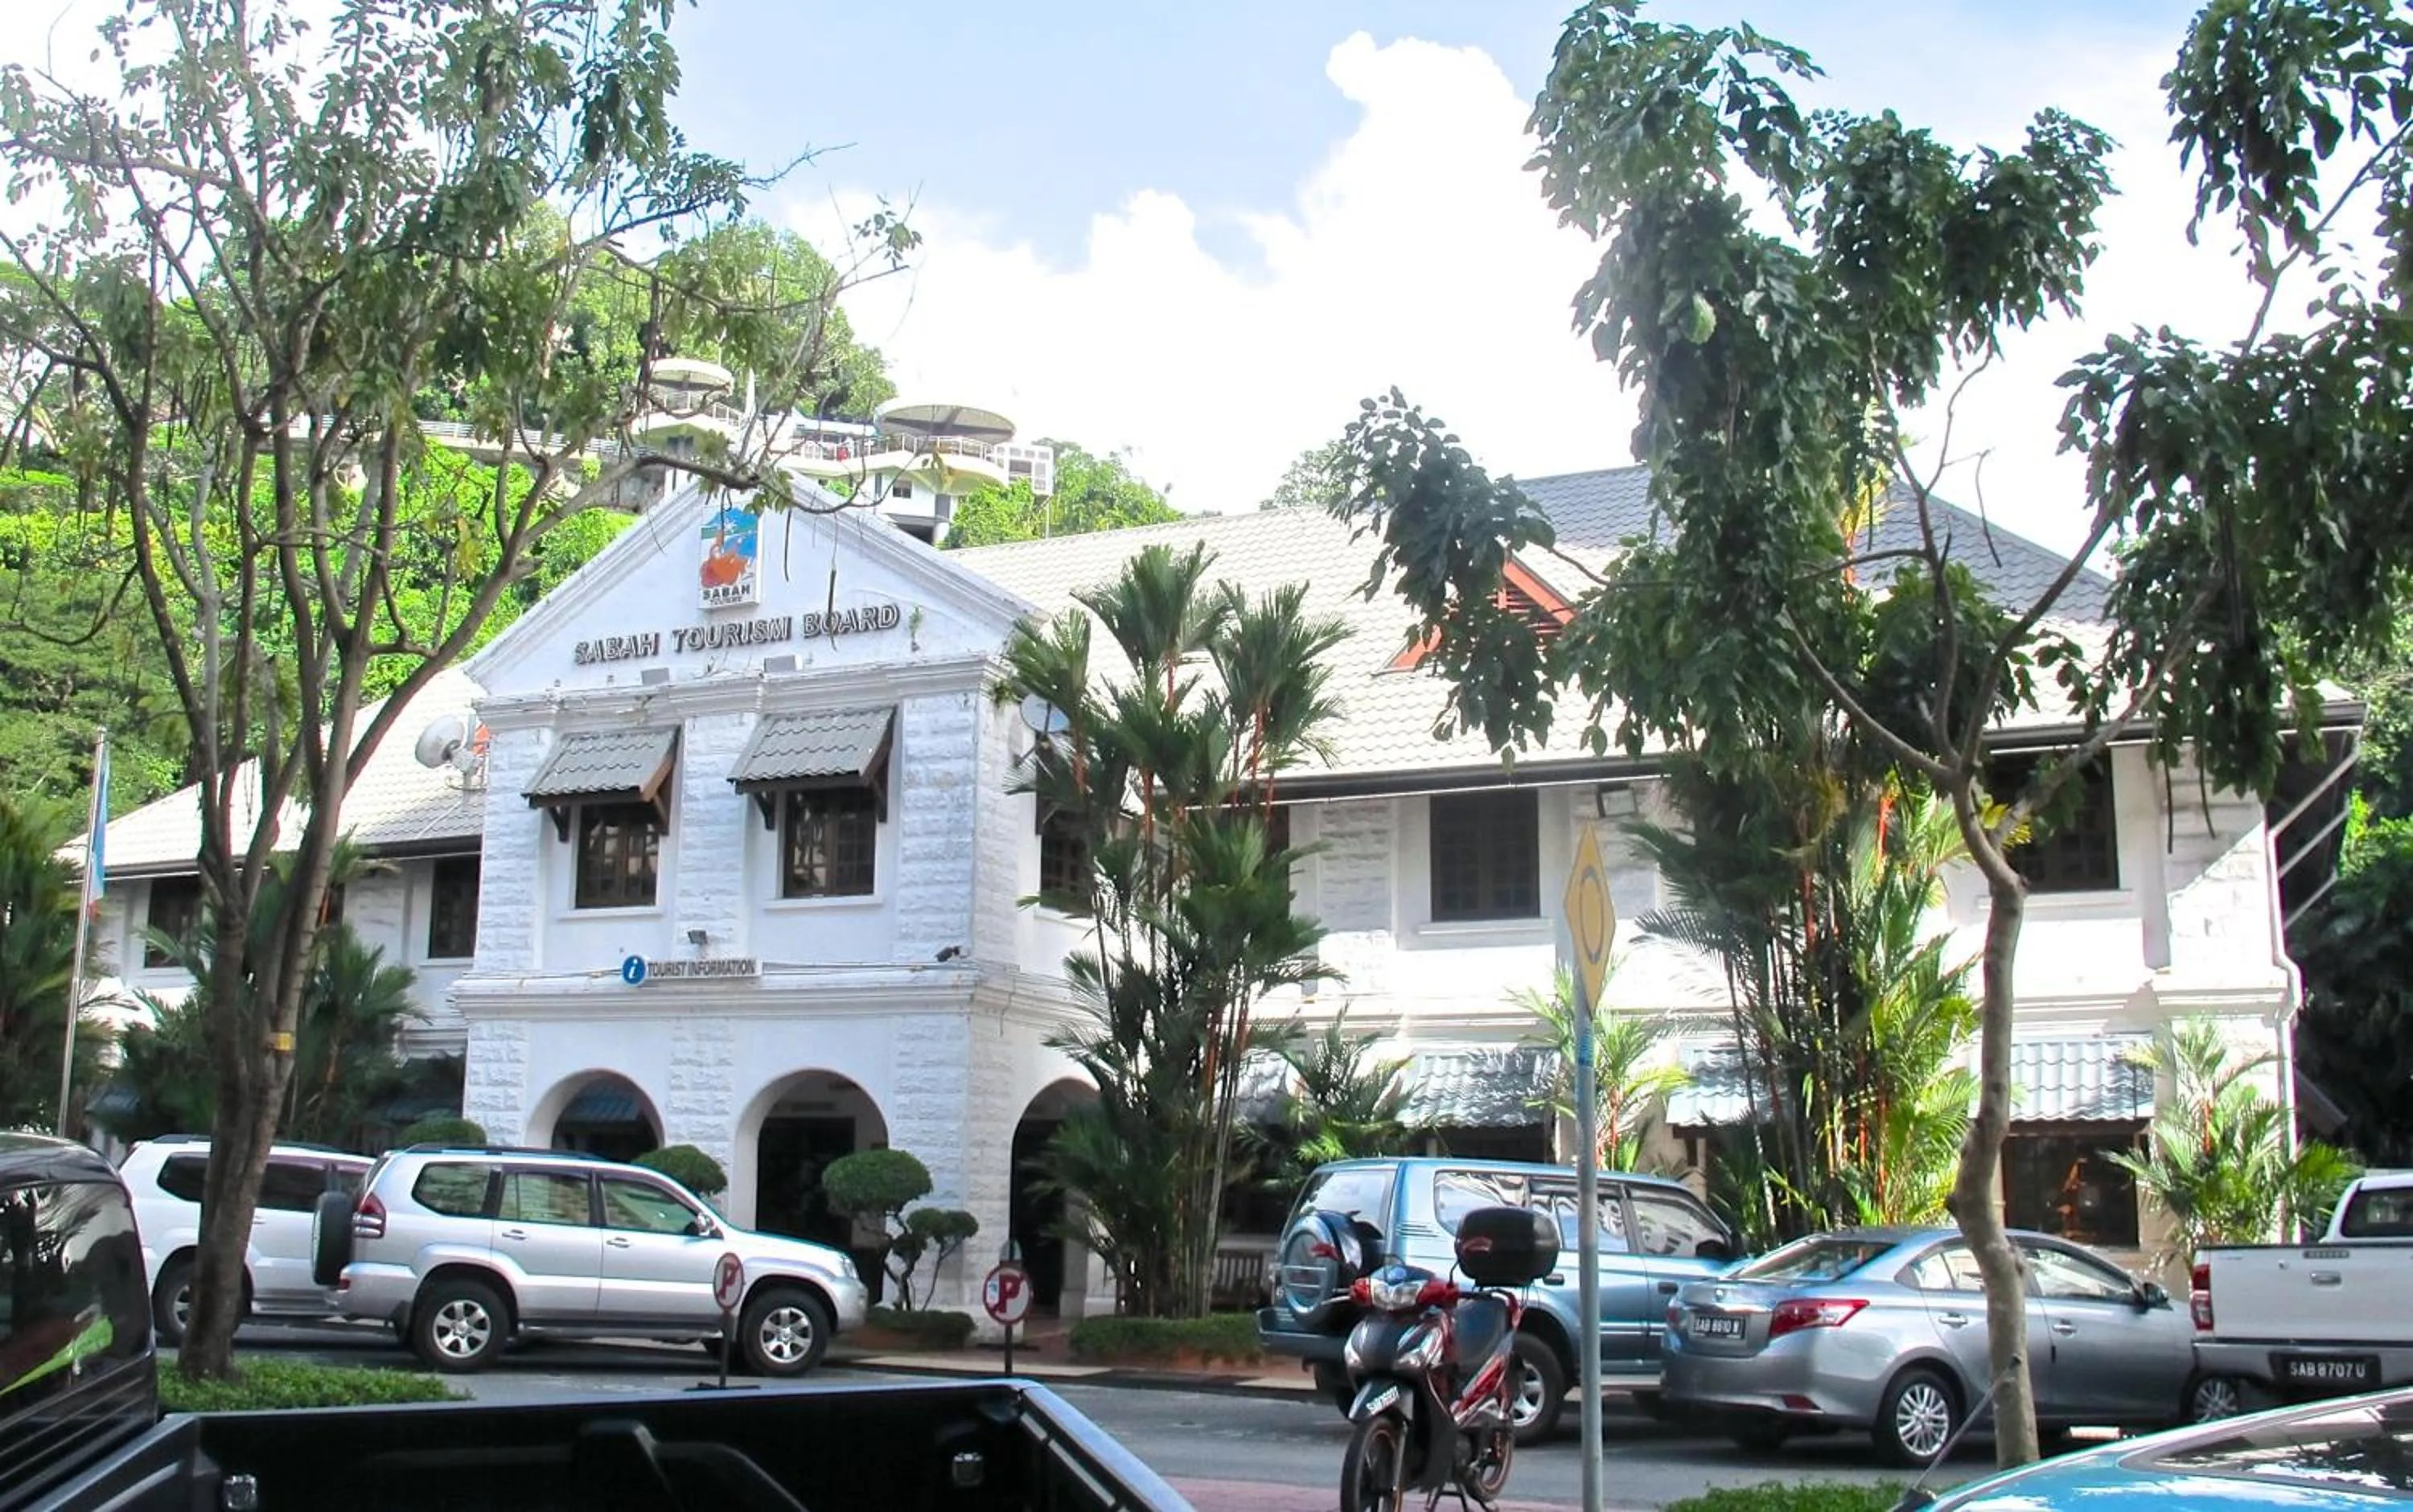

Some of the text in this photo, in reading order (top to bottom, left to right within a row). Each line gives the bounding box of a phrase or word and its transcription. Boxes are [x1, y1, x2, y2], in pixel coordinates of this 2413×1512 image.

[702, 584, 751, 601] SABAH
[573, 604, 900, 664] SABAH TOURISM BOARD
[647, 961, 688, 978] TOURIST
[689, 958, 756, 977] INFORMATION
